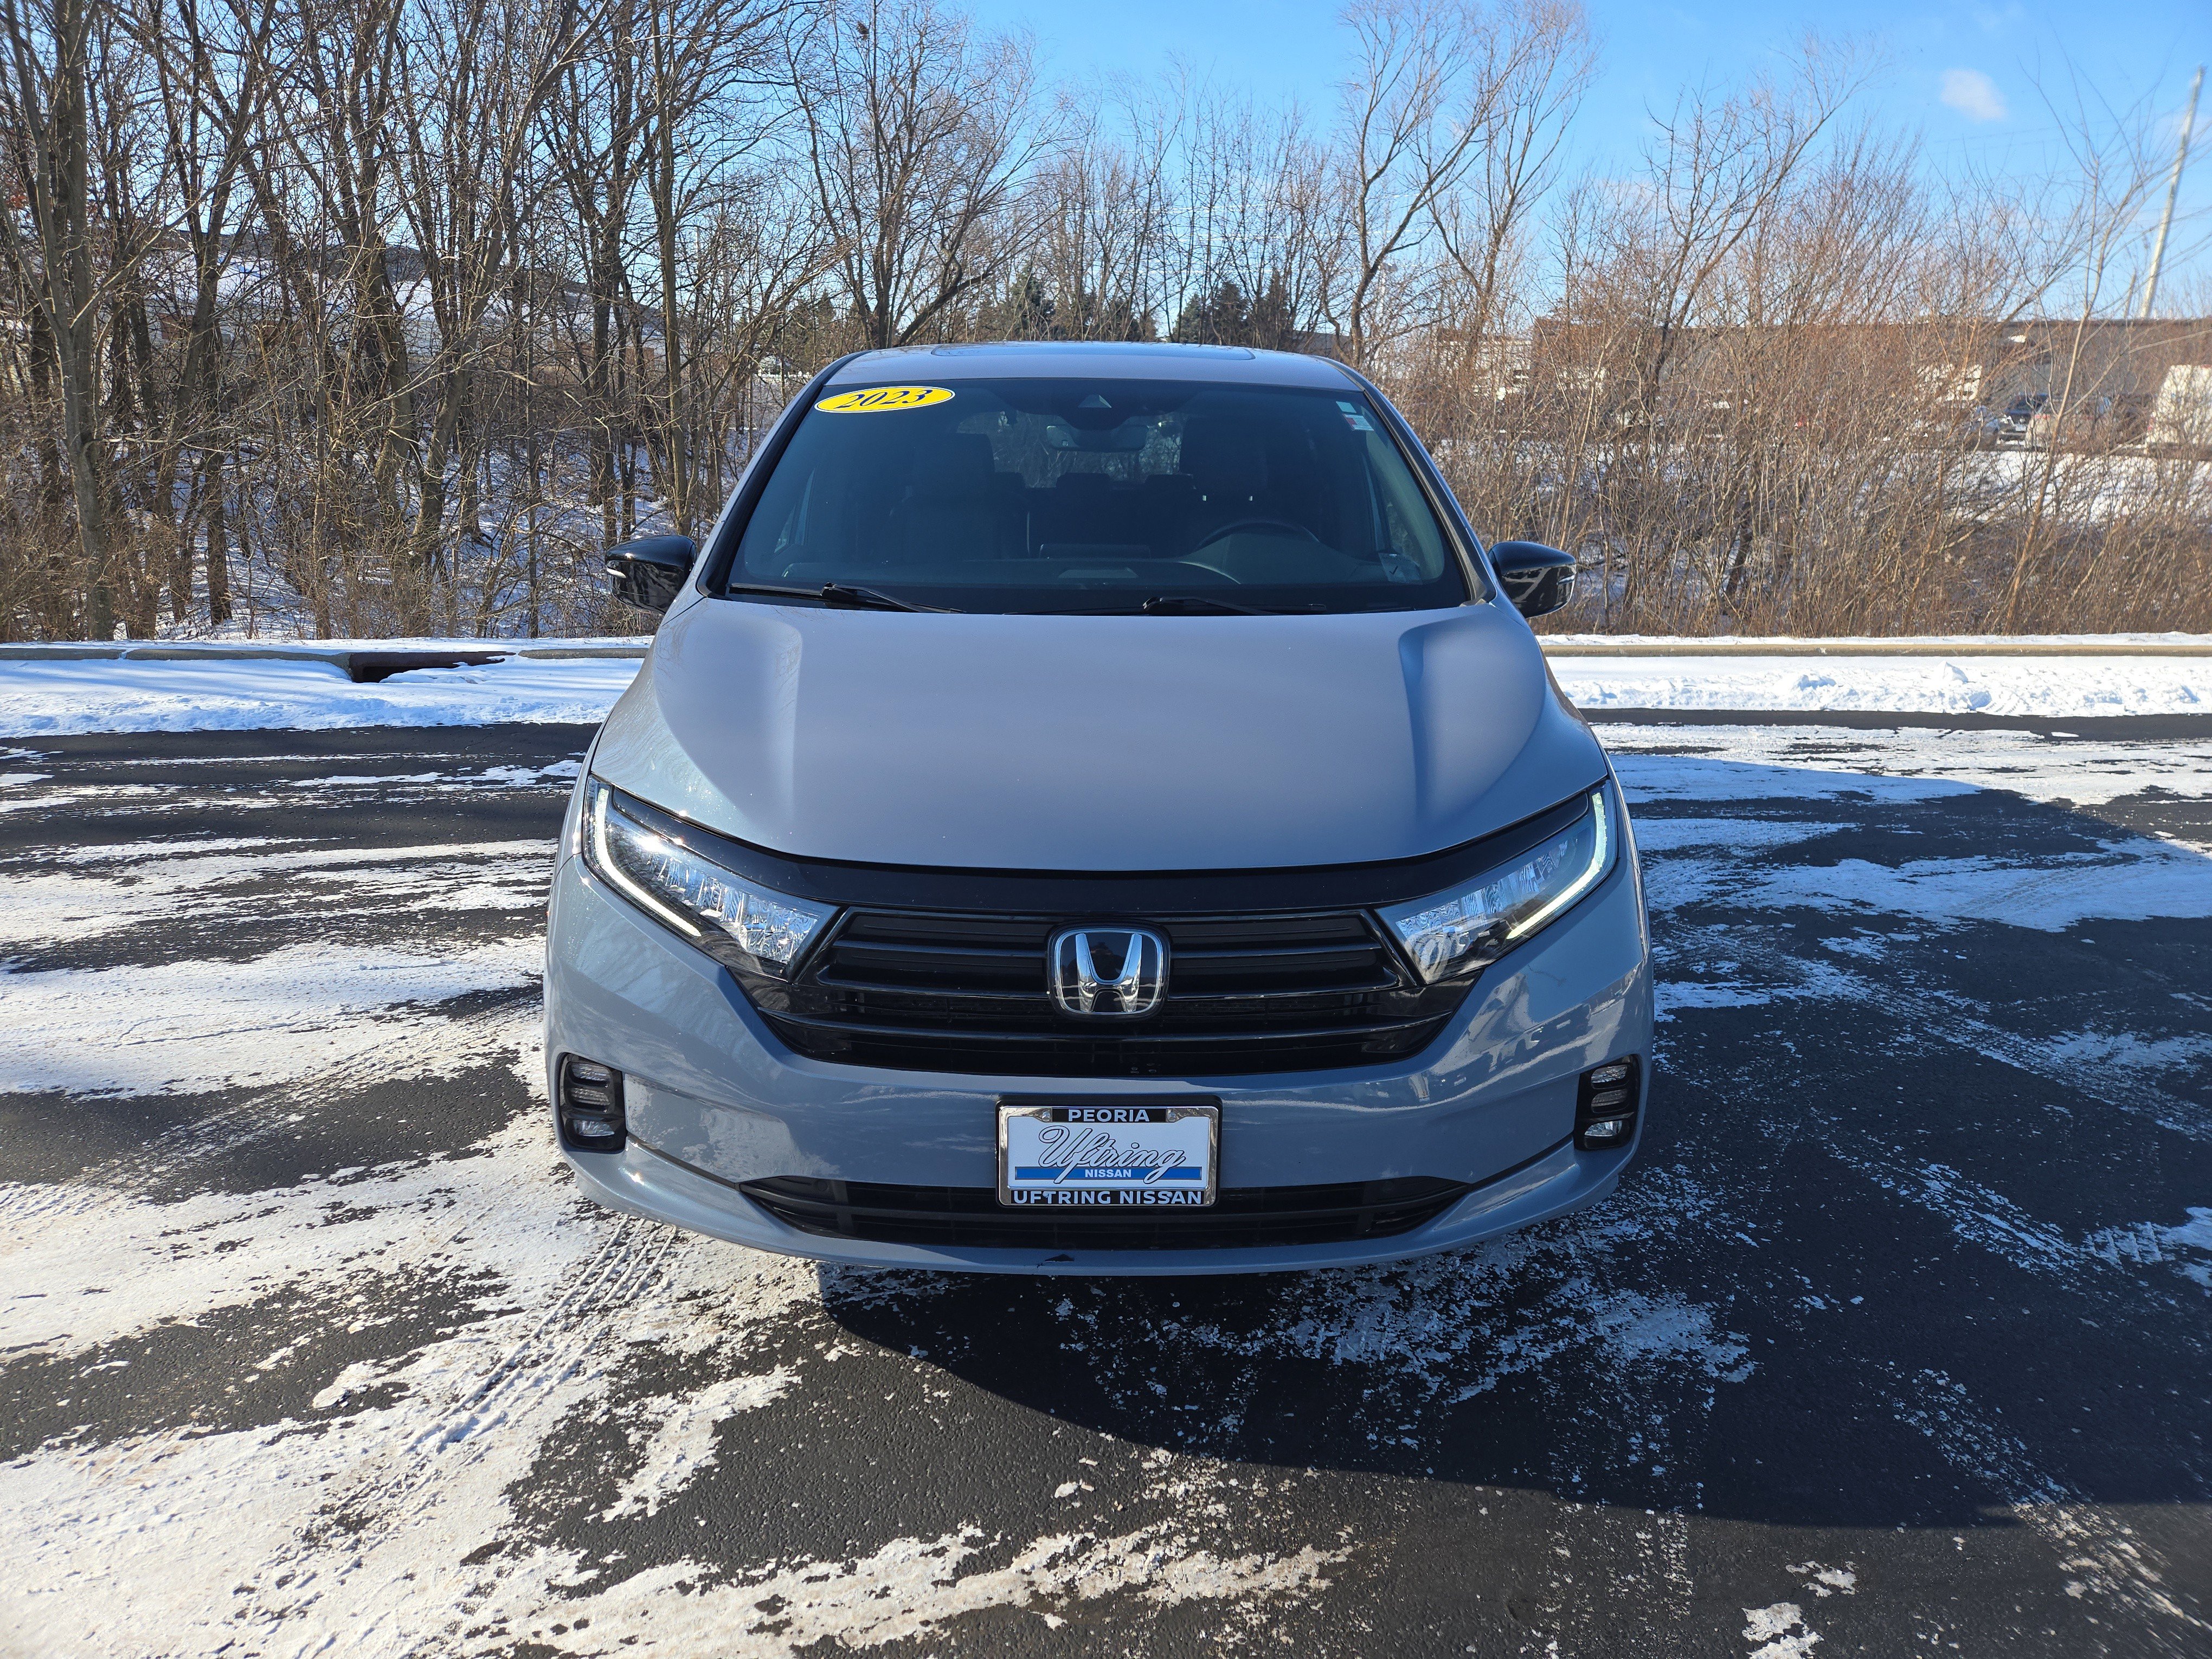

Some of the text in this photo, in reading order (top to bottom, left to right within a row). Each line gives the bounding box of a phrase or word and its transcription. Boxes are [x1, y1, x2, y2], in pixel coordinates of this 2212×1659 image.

[833, 390, 933, 409] 2023
[1068, 1109, 1150, 1122] PEORIA
[1038, 1125, 1186, 1184] Uftring
[1084, 1169, 1132, 1178] NISSAN
[1013, 1191, 1202, 1204] UFTRING NISSAN
